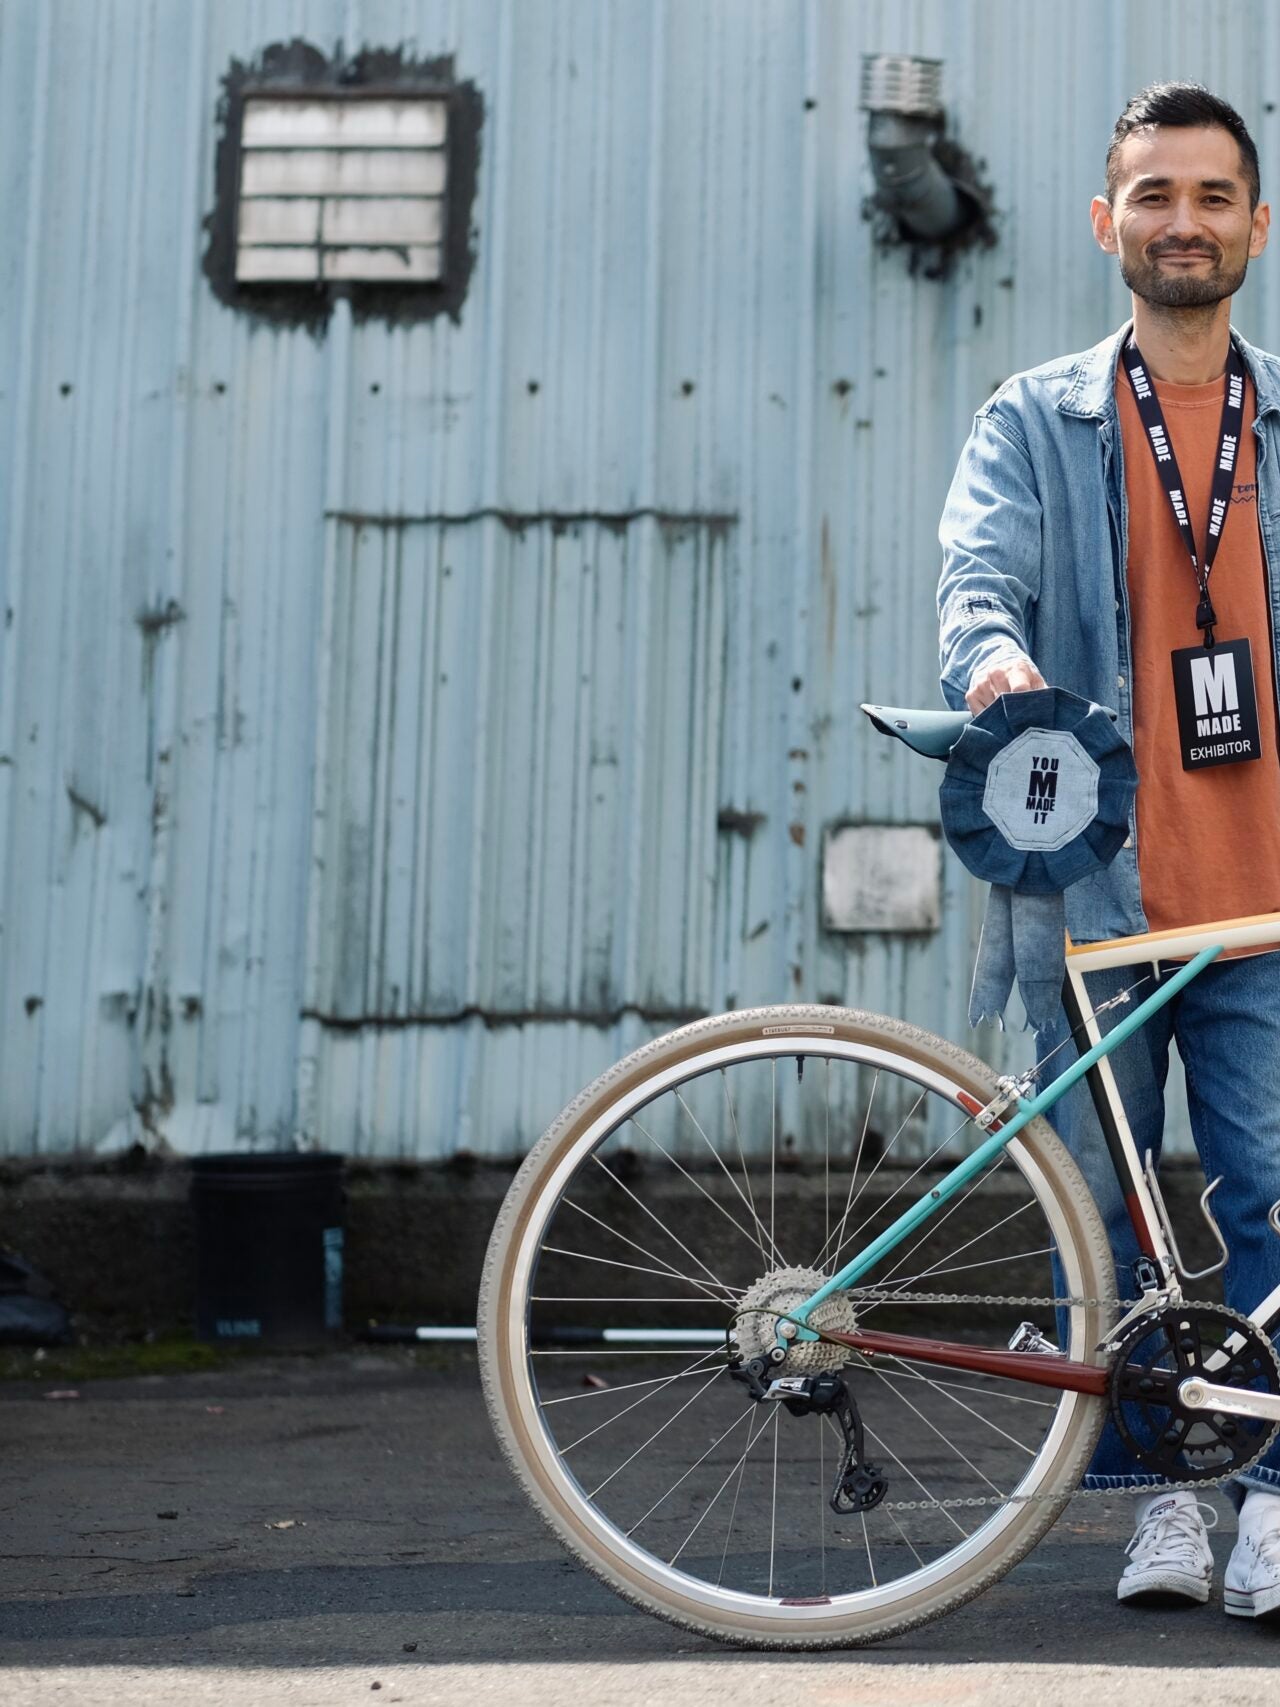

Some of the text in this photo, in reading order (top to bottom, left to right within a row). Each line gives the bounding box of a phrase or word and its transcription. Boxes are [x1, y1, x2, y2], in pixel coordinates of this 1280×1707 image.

[1129, 365, 1152, 400] MADE
[1228, 373, 1243, 409] MADE
[1149, 425, 1171, 462] MADE
[1219, 434, 1237, 471] MADE
[1169, 489, 1189, 526] MADE
[1209, 498, 1226, 536] MADE
[1190, 652, 1239, 716] M
[1196, 714, 1242, 738] MADE
[1032, 756, 1059, 770] YOU
[1190, 740, 1251, 761] EXHIBITOR
[1028, 770, 1058, 798] M
[1025, 796, 1056, 812] MADE
[1033, 812, 1048, 825] IT
